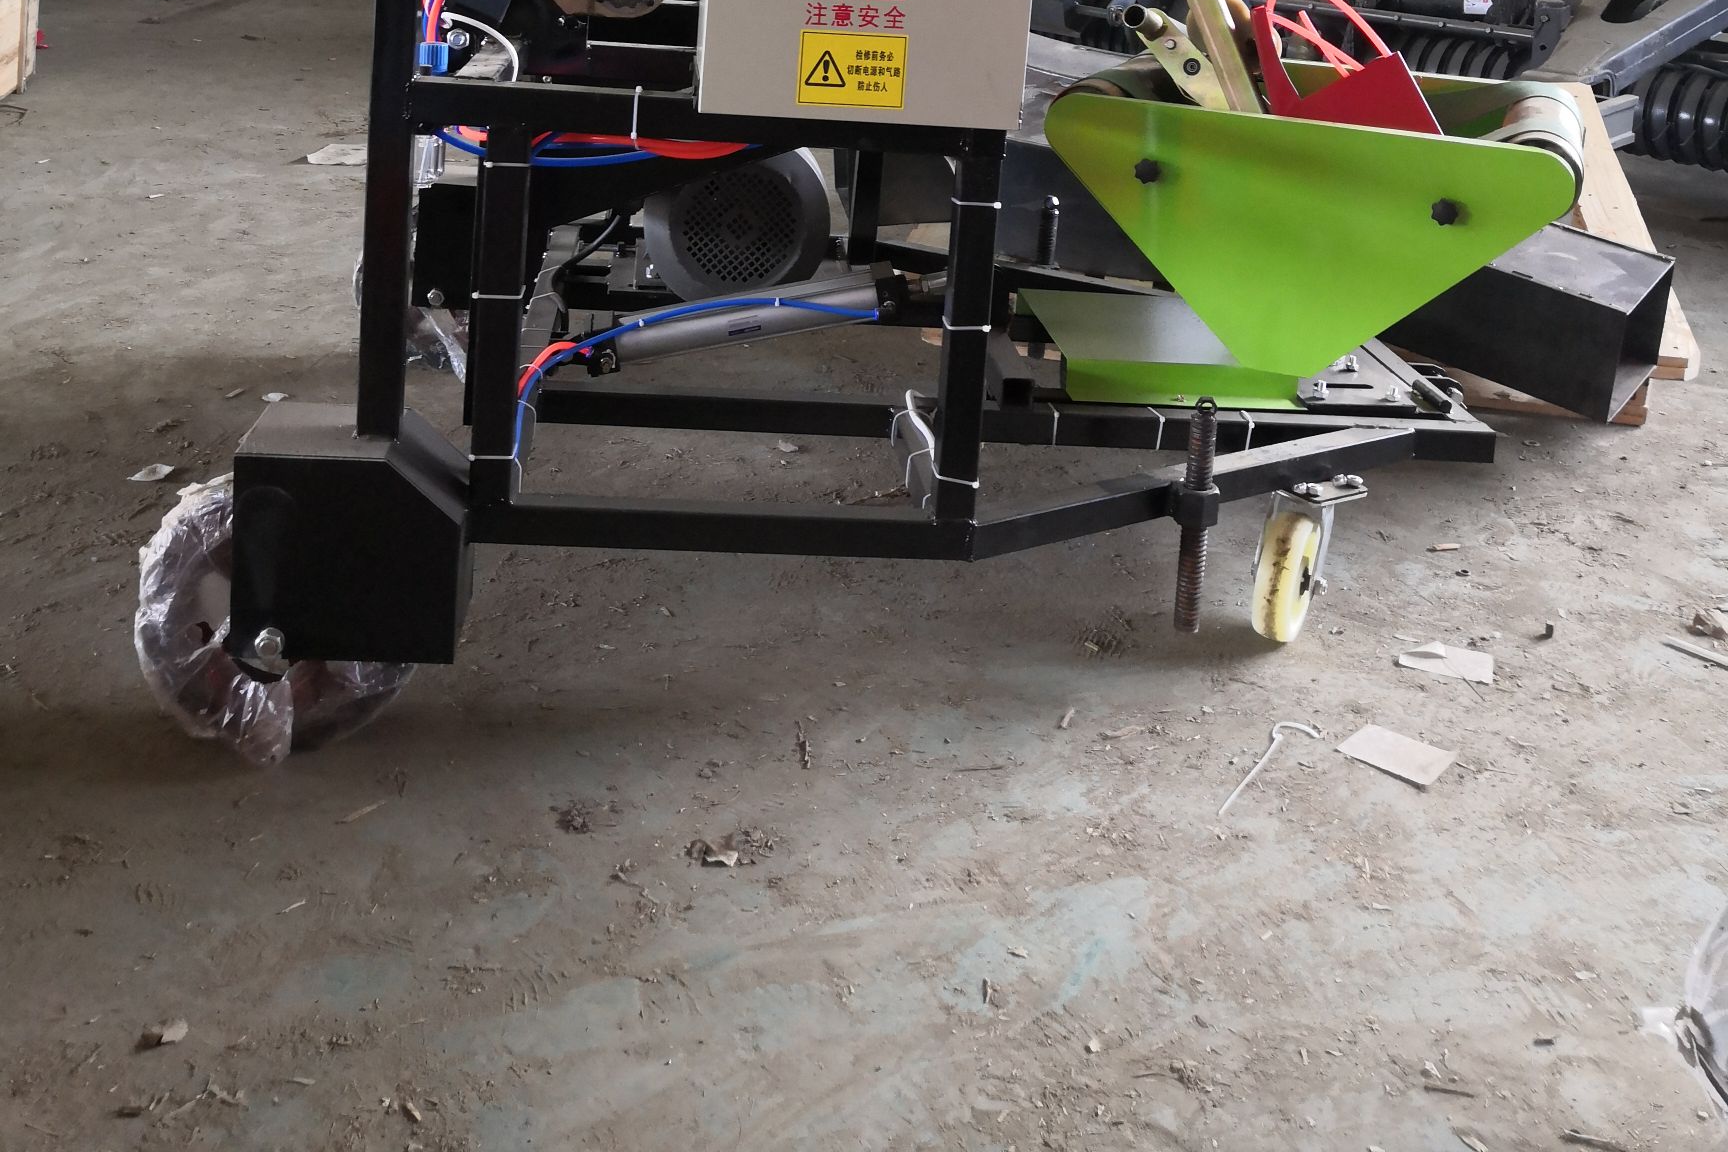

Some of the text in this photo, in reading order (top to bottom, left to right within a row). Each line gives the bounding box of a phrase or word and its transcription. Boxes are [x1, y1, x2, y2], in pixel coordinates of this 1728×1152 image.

[805, 2, 906, 29] 注意安全
[856, 49, 894, 62] 检修前务必
[847, 64, 901, 78] 切断电源和气路
[857, 80, 888, 93] 防止伤人
